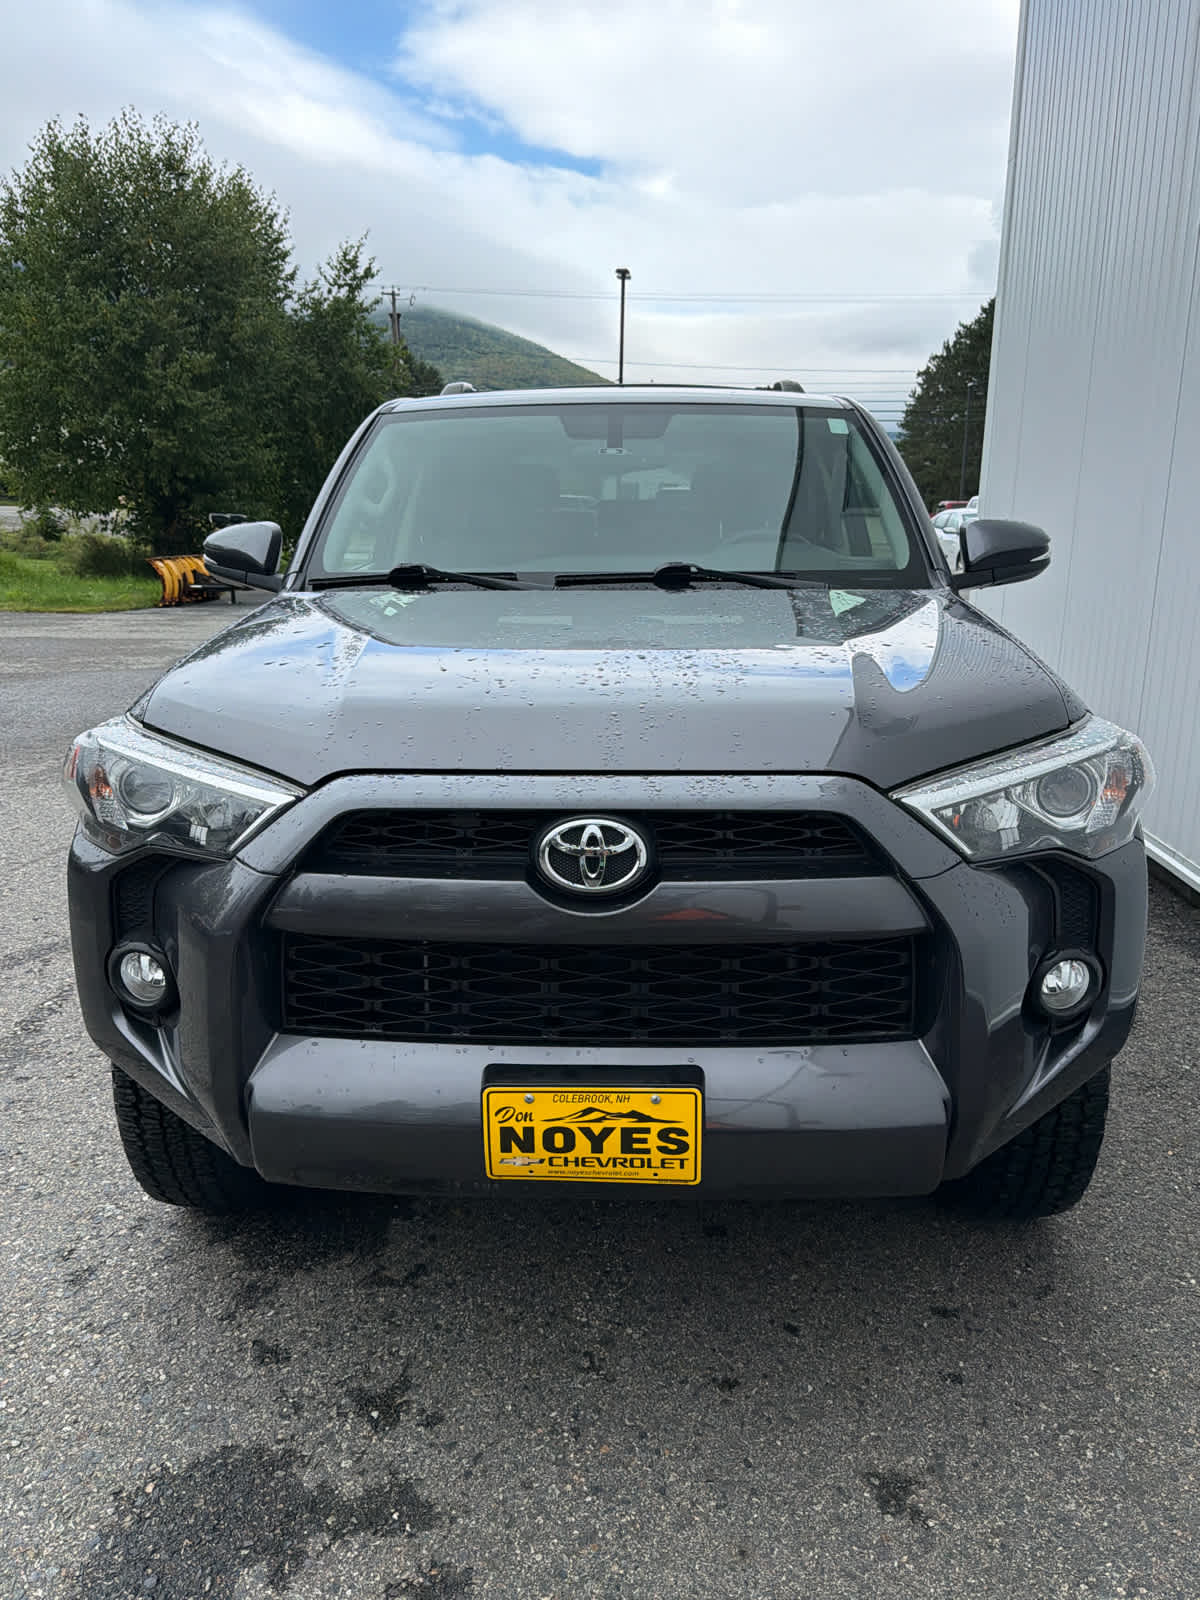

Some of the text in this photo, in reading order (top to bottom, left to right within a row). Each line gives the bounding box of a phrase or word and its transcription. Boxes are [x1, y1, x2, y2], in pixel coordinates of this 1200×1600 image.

[552, 1094, 631, 1105] COLEBROOK, NH
[494, 1106, 534, 1123] Don
[499, 1126, 690, 1155] NOYES
[548, 1156, 689, 1169] CHEVROLET
